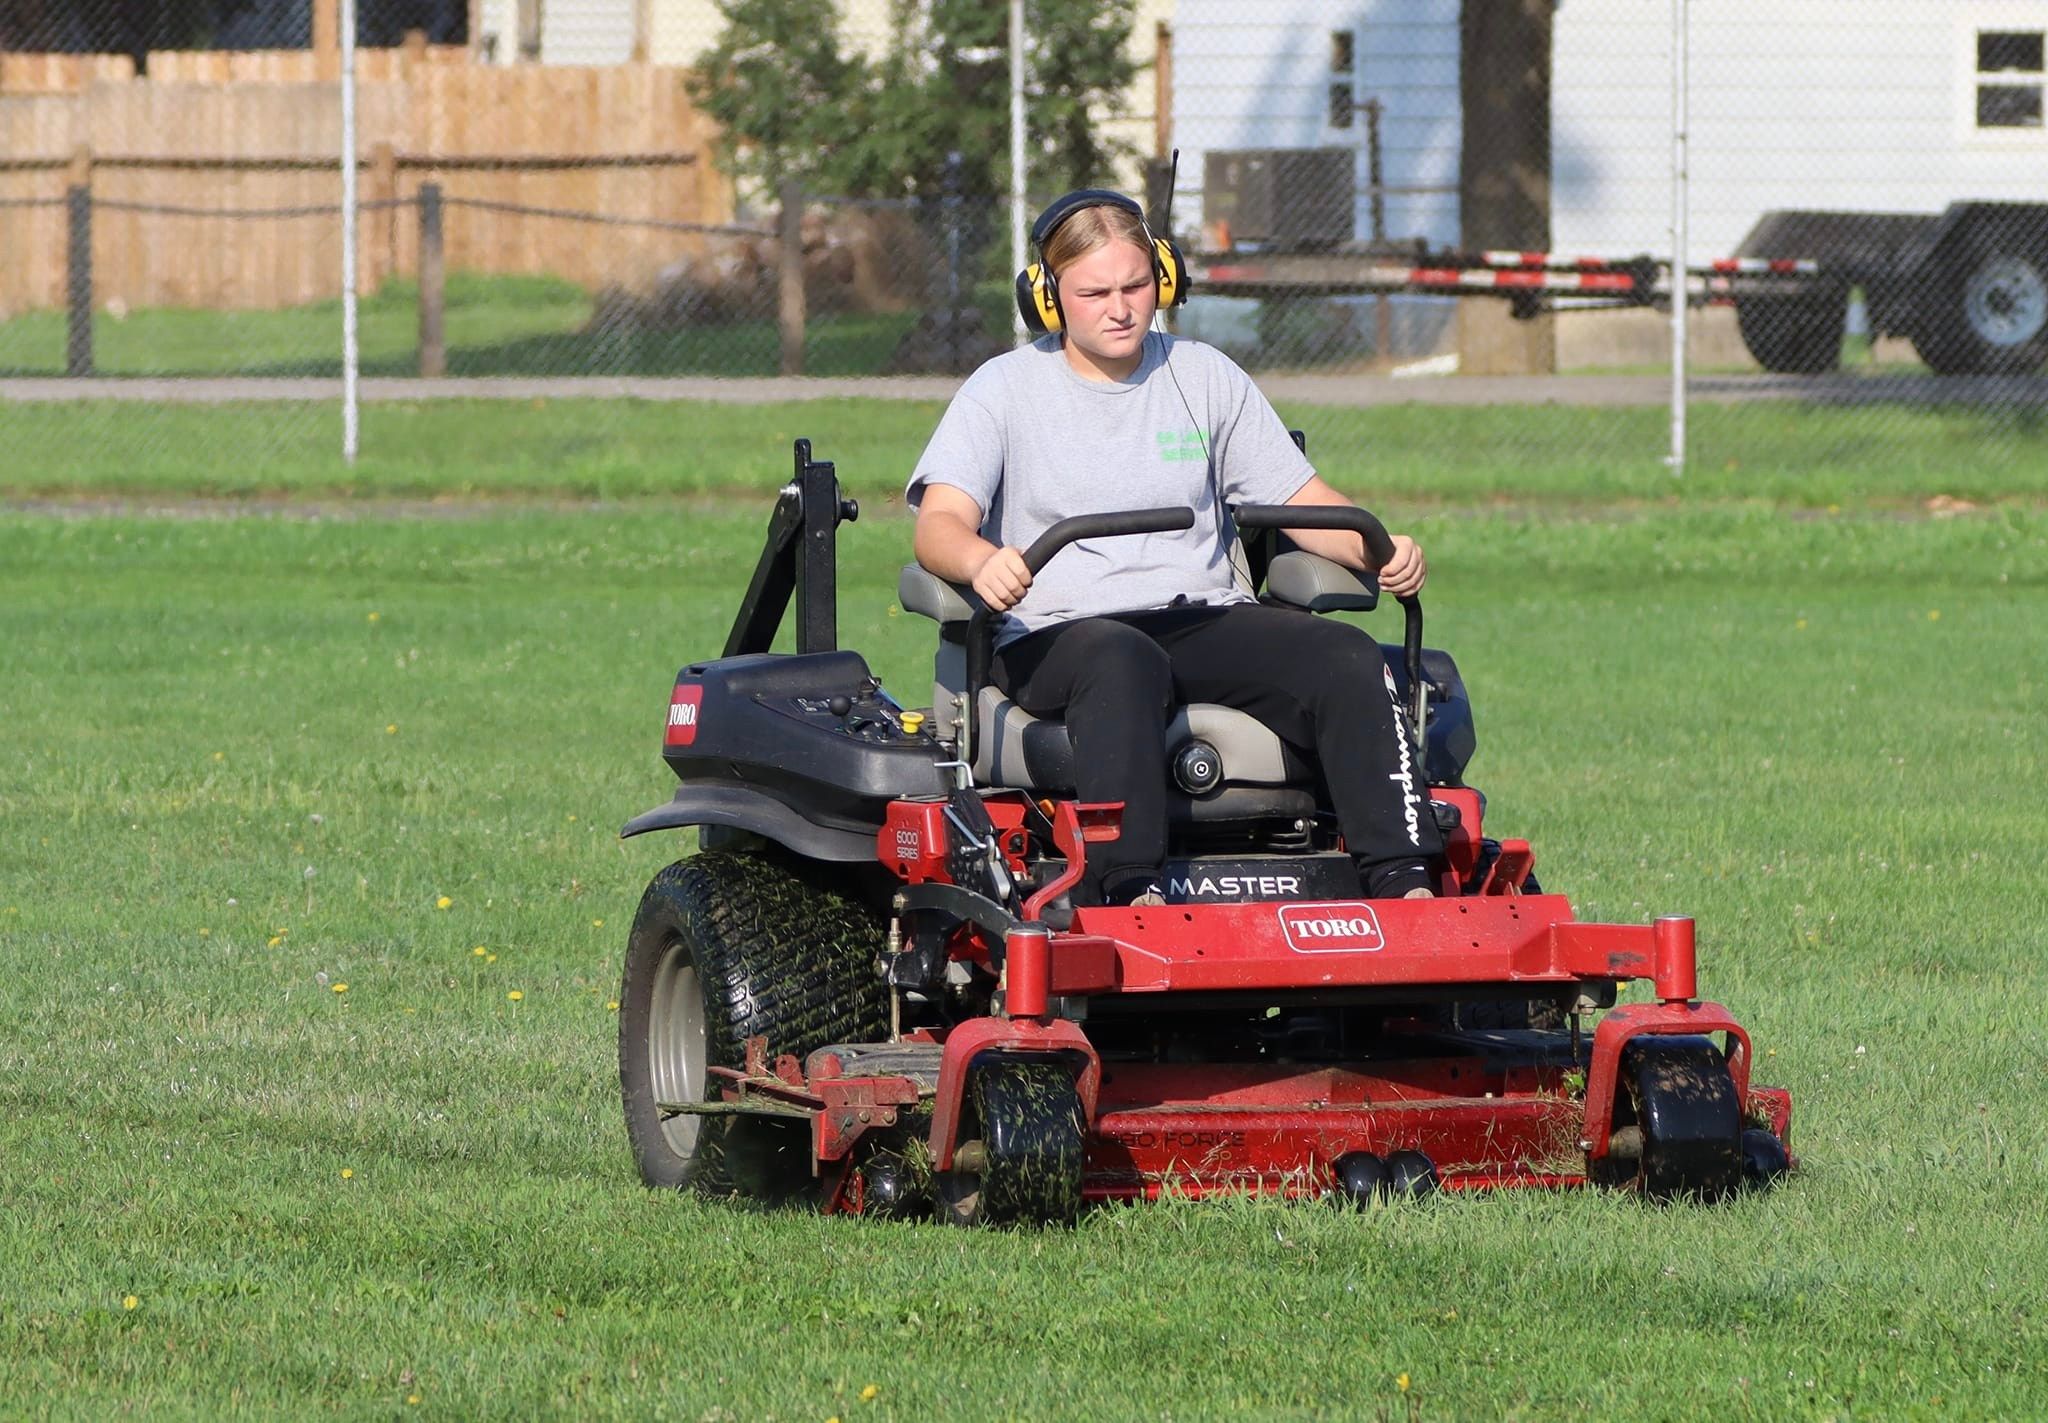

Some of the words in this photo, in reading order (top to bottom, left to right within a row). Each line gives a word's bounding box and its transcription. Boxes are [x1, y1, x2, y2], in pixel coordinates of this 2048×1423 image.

[669, 703, 695, 726] TORO
[896, 830, 919, 845] 6000
[896, 846, 919, 860] SERIES
[1169, 876, 1300, 896] MASTER
[1289, 917, 1373, 939] TORO
